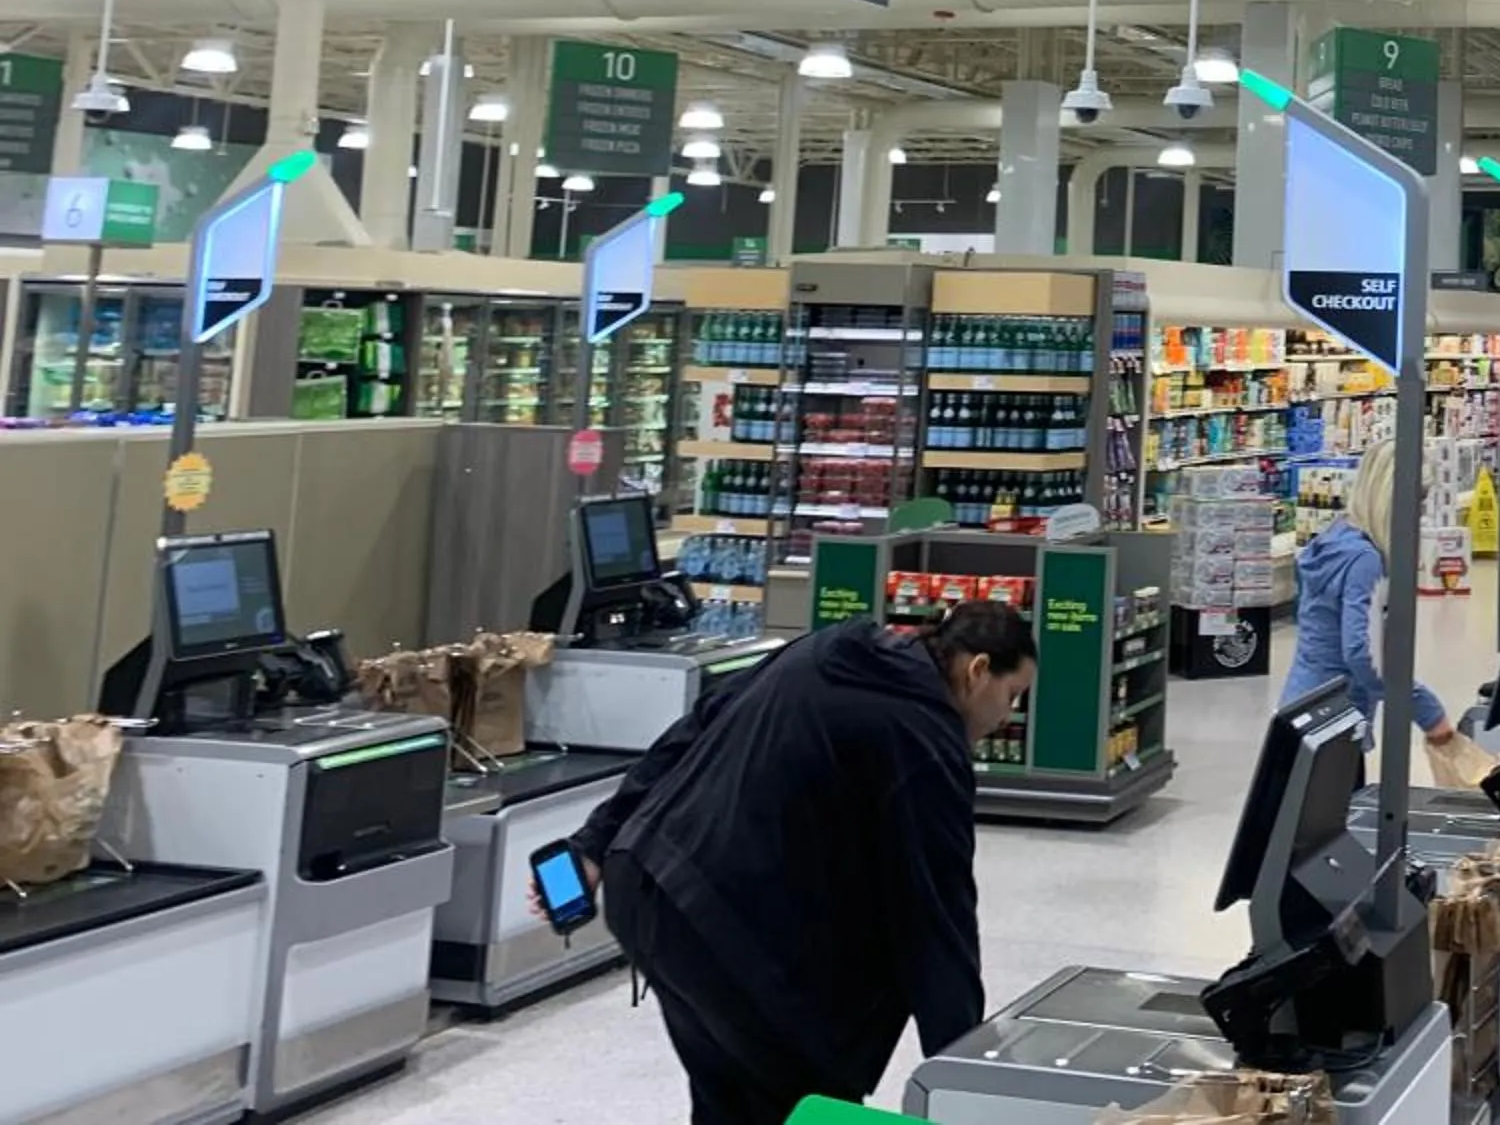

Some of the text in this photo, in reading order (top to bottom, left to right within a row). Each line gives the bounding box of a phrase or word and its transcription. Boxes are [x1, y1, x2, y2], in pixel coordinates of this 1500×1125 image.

[603, 51, 637, 81] 10
[1383, 40, 1400, 70] 9
[65, 192, 85, 229] 6
[1361, 278, 1397, 294] SELF
[1311, 294, 1396, 310] CHECKOUT
